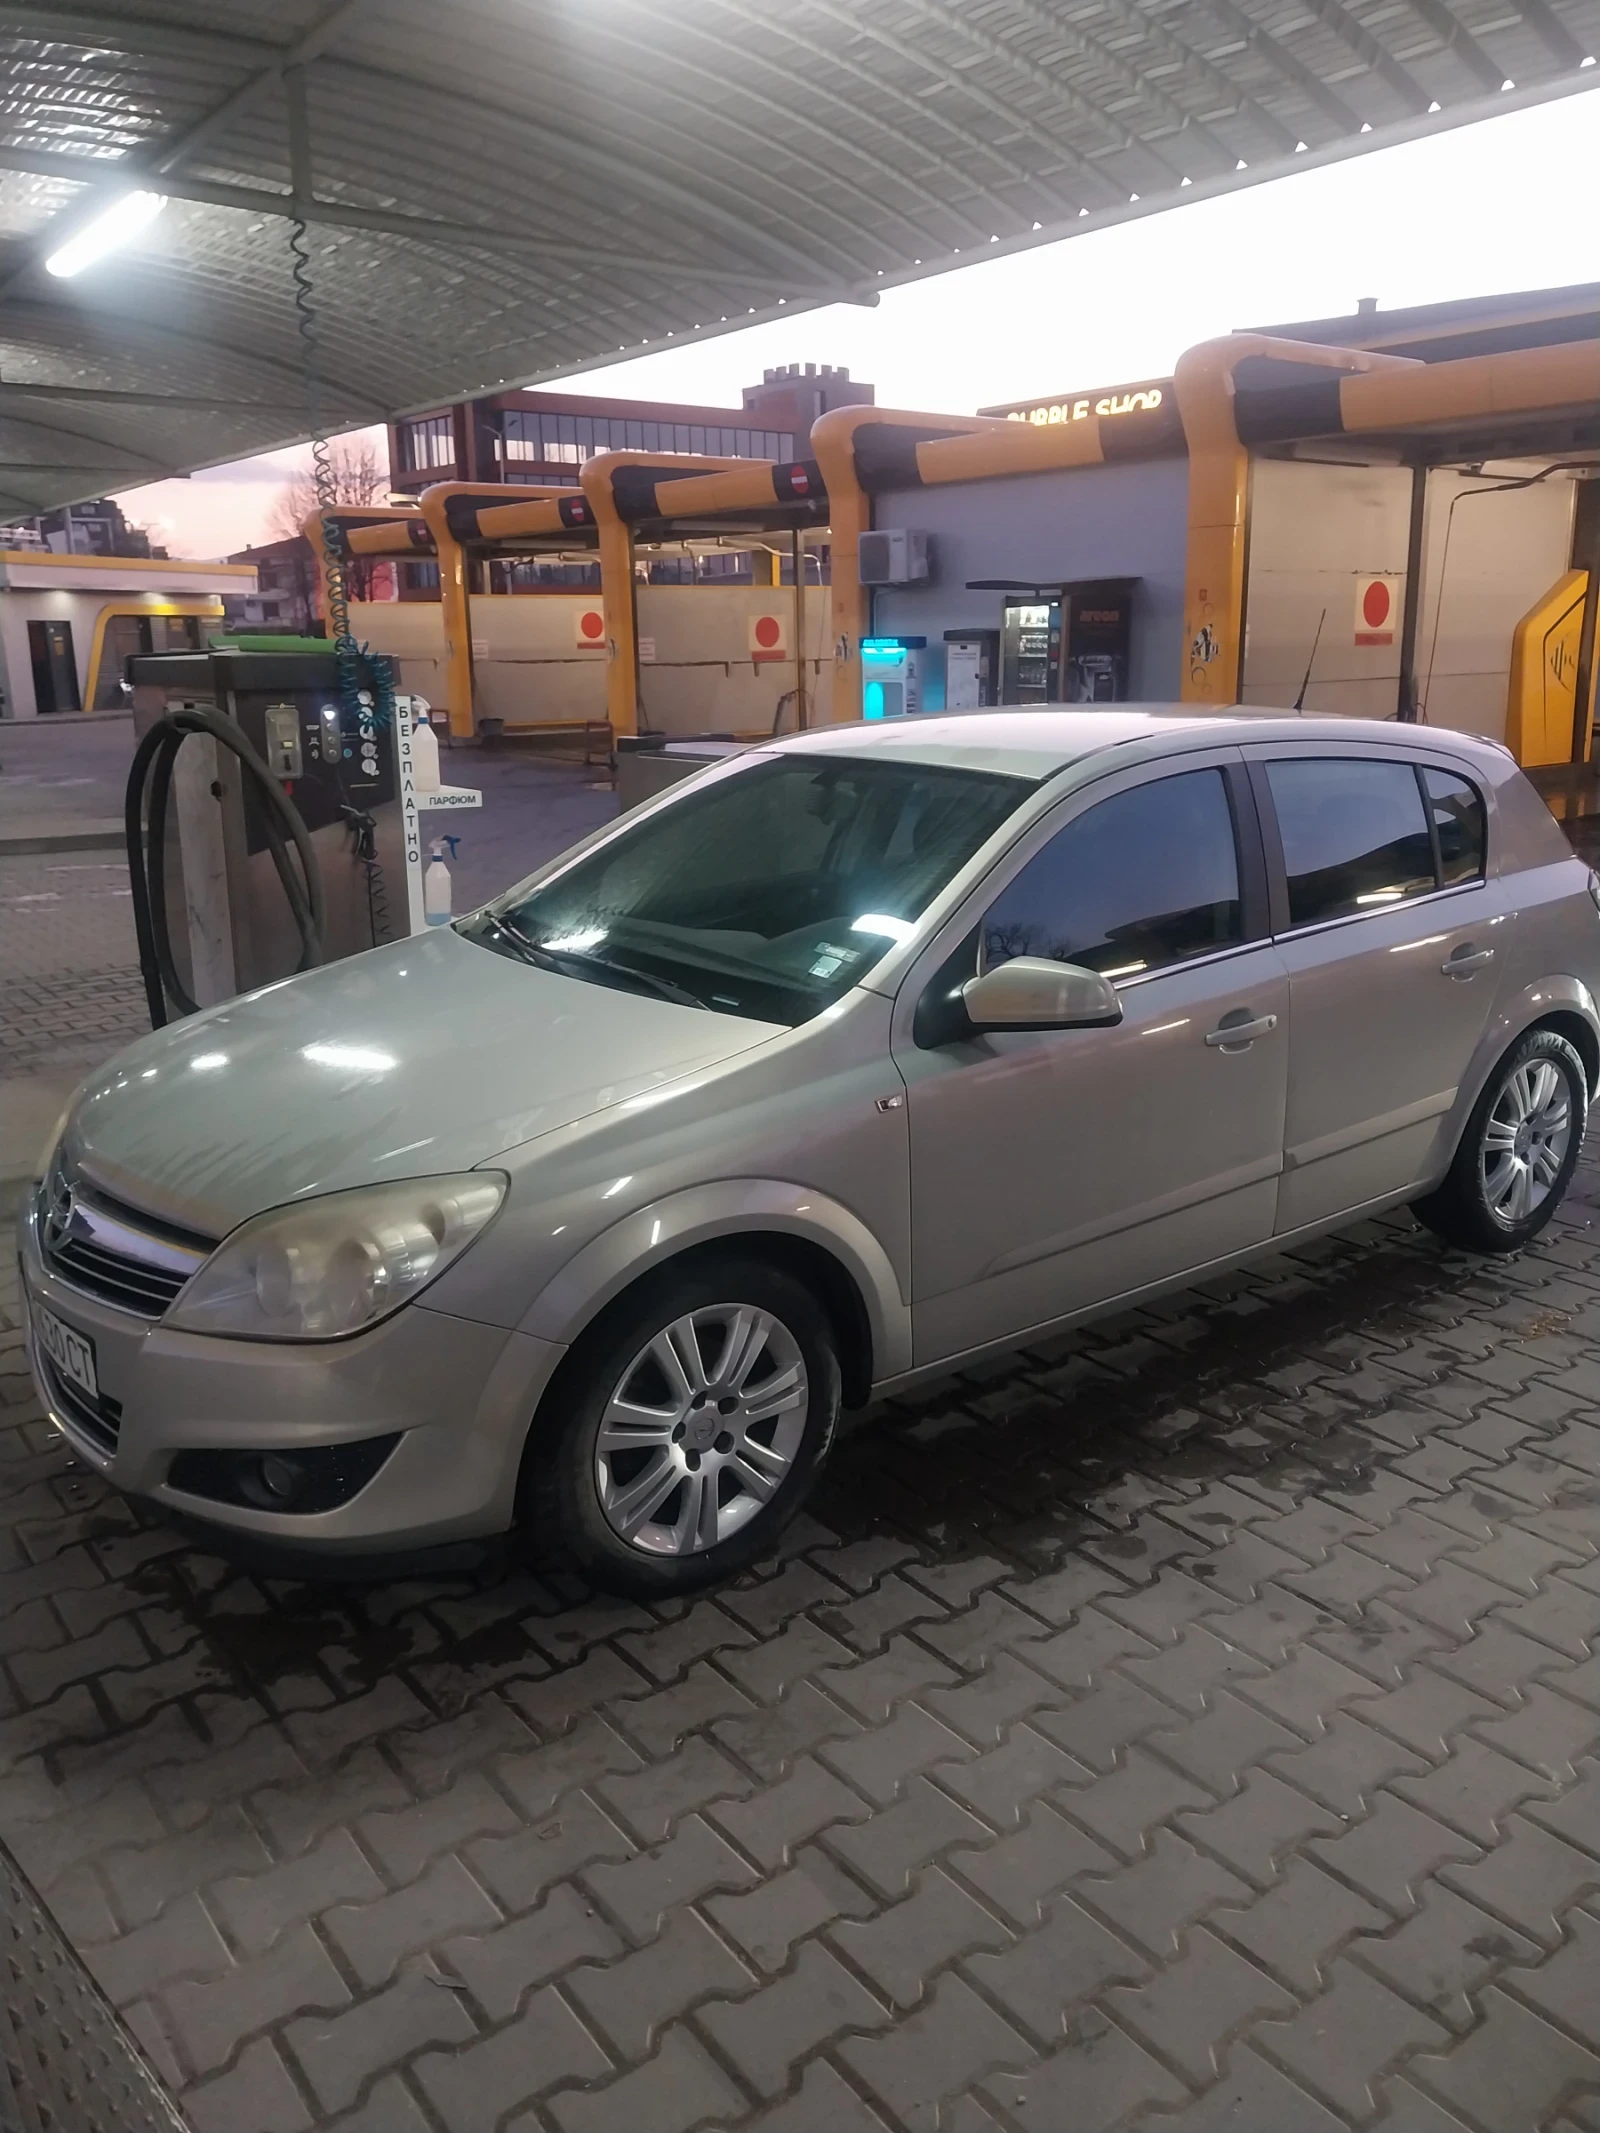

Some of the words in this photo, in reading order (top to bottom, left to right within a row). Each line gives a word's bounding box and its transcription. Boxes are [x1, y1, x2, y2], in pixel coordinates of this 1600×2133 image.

[1007, 400, 1090, 426] BBLE
[398, 706, 419, 863] БЕЗПЛАТНО
[429, 795, 476, 806] ПАРФЮМ
